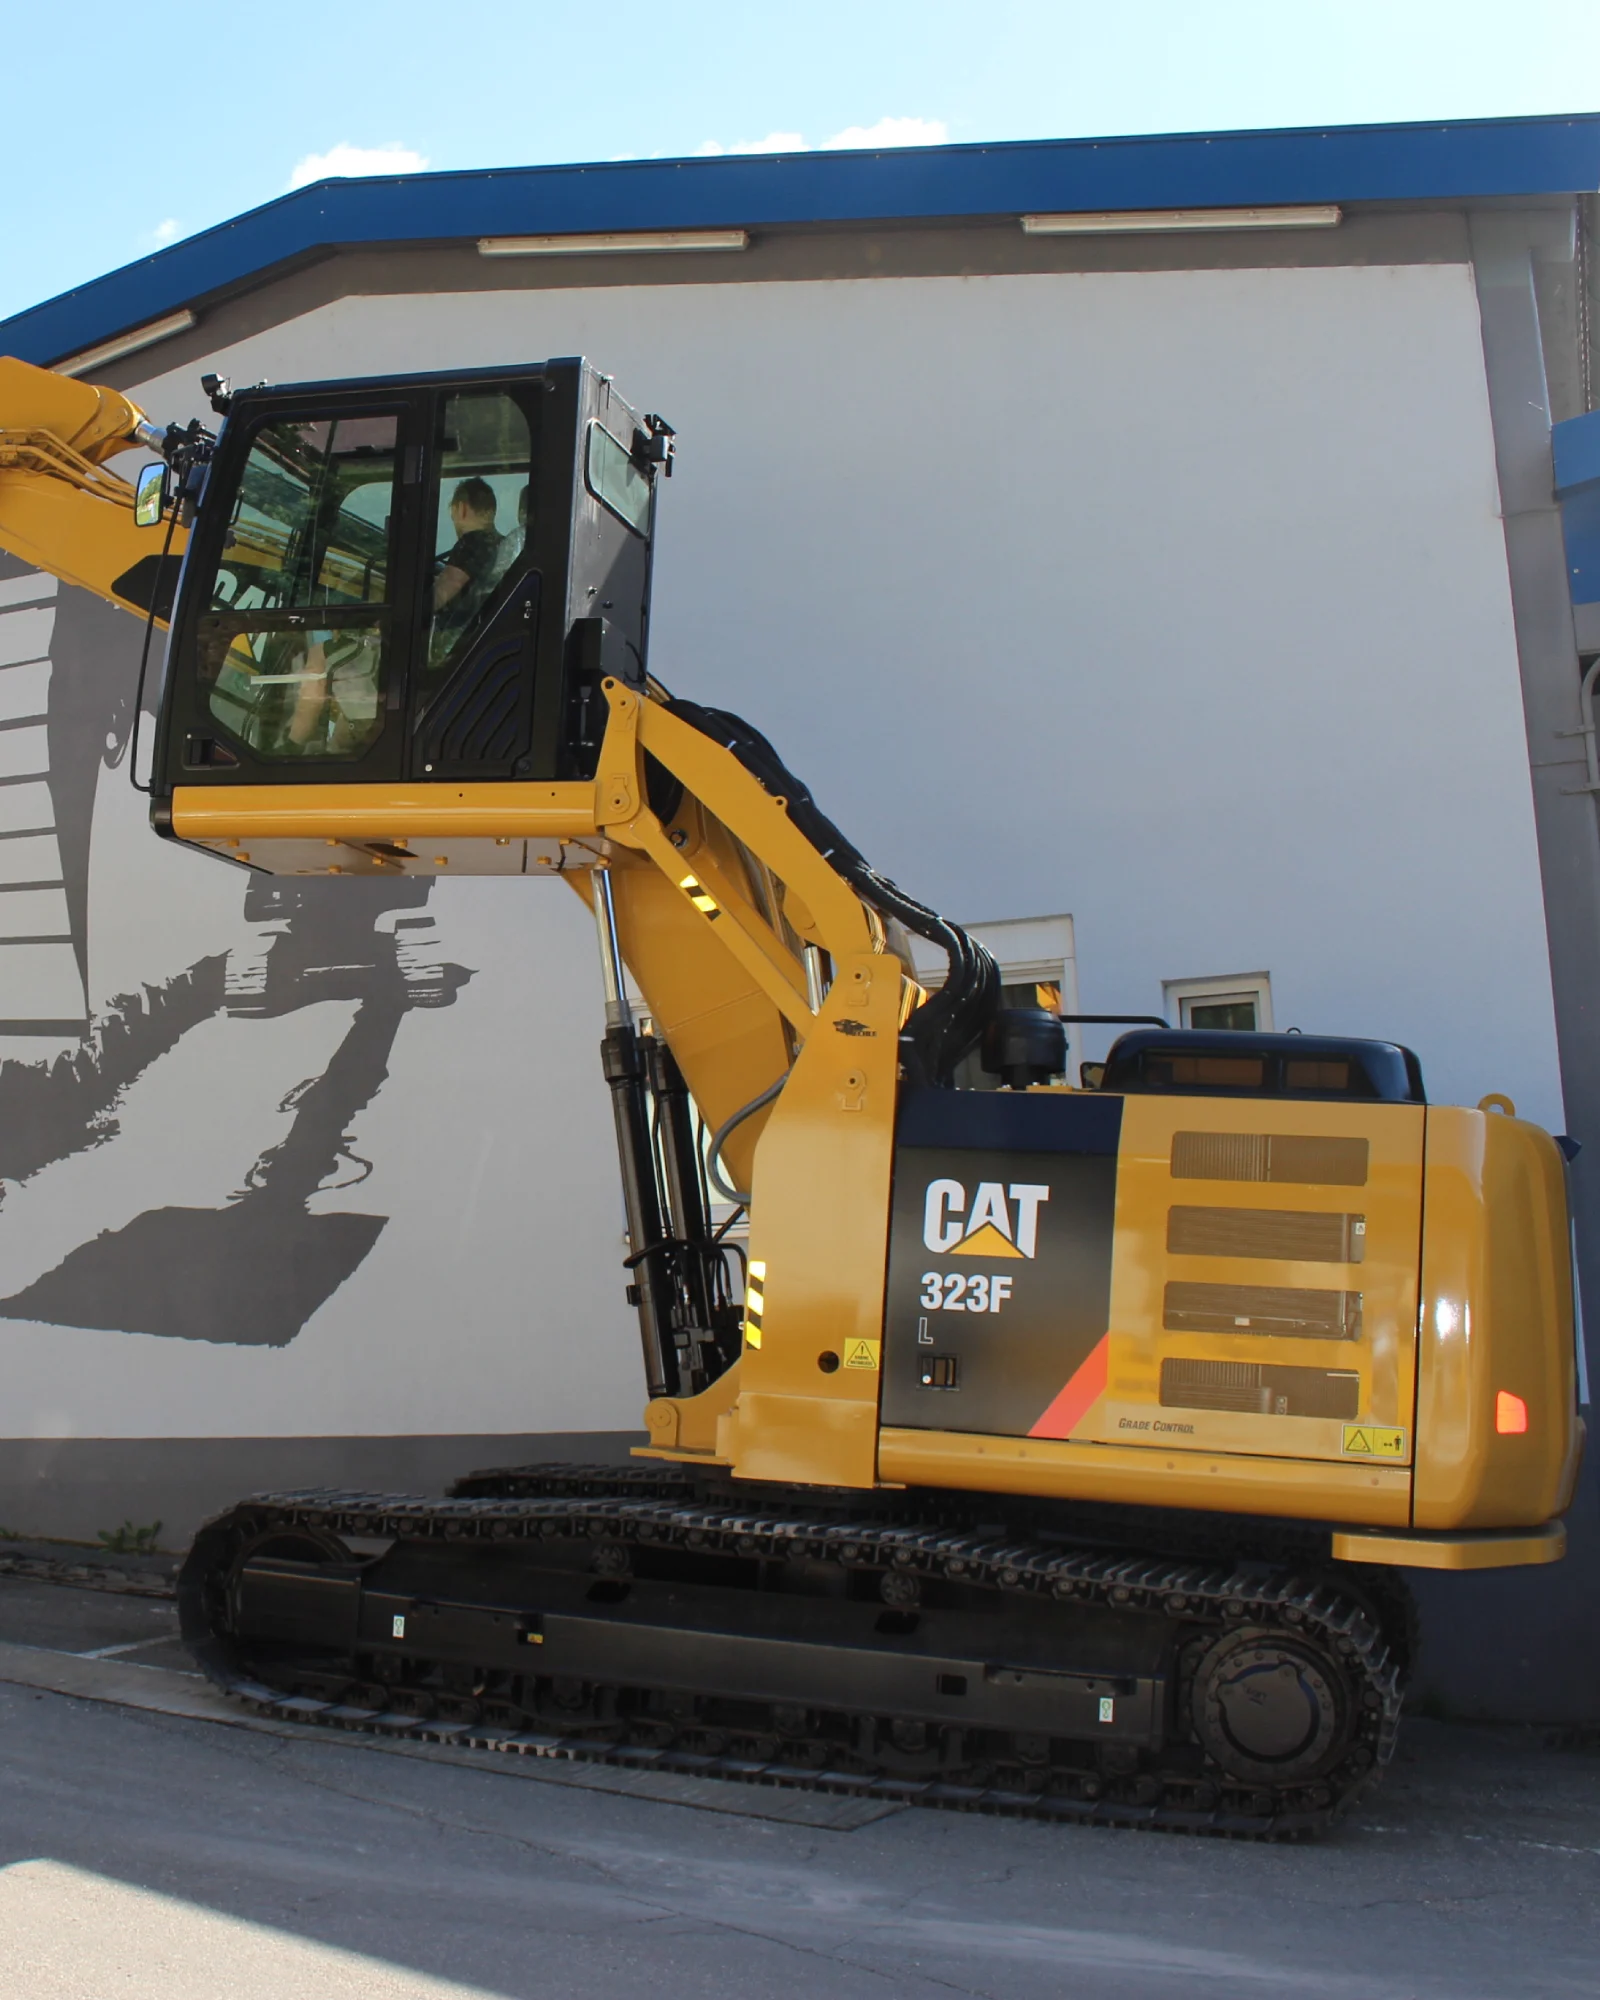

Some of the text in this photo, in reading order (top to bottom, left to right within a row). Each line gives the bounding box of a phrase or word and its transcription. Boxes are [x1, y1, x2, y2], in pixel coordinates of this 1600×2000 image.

[923, 1178, 1050, 1260] CAT
[919, 1271, 1013, 1313] 323F
[917, 1316, 934, 1345] L
